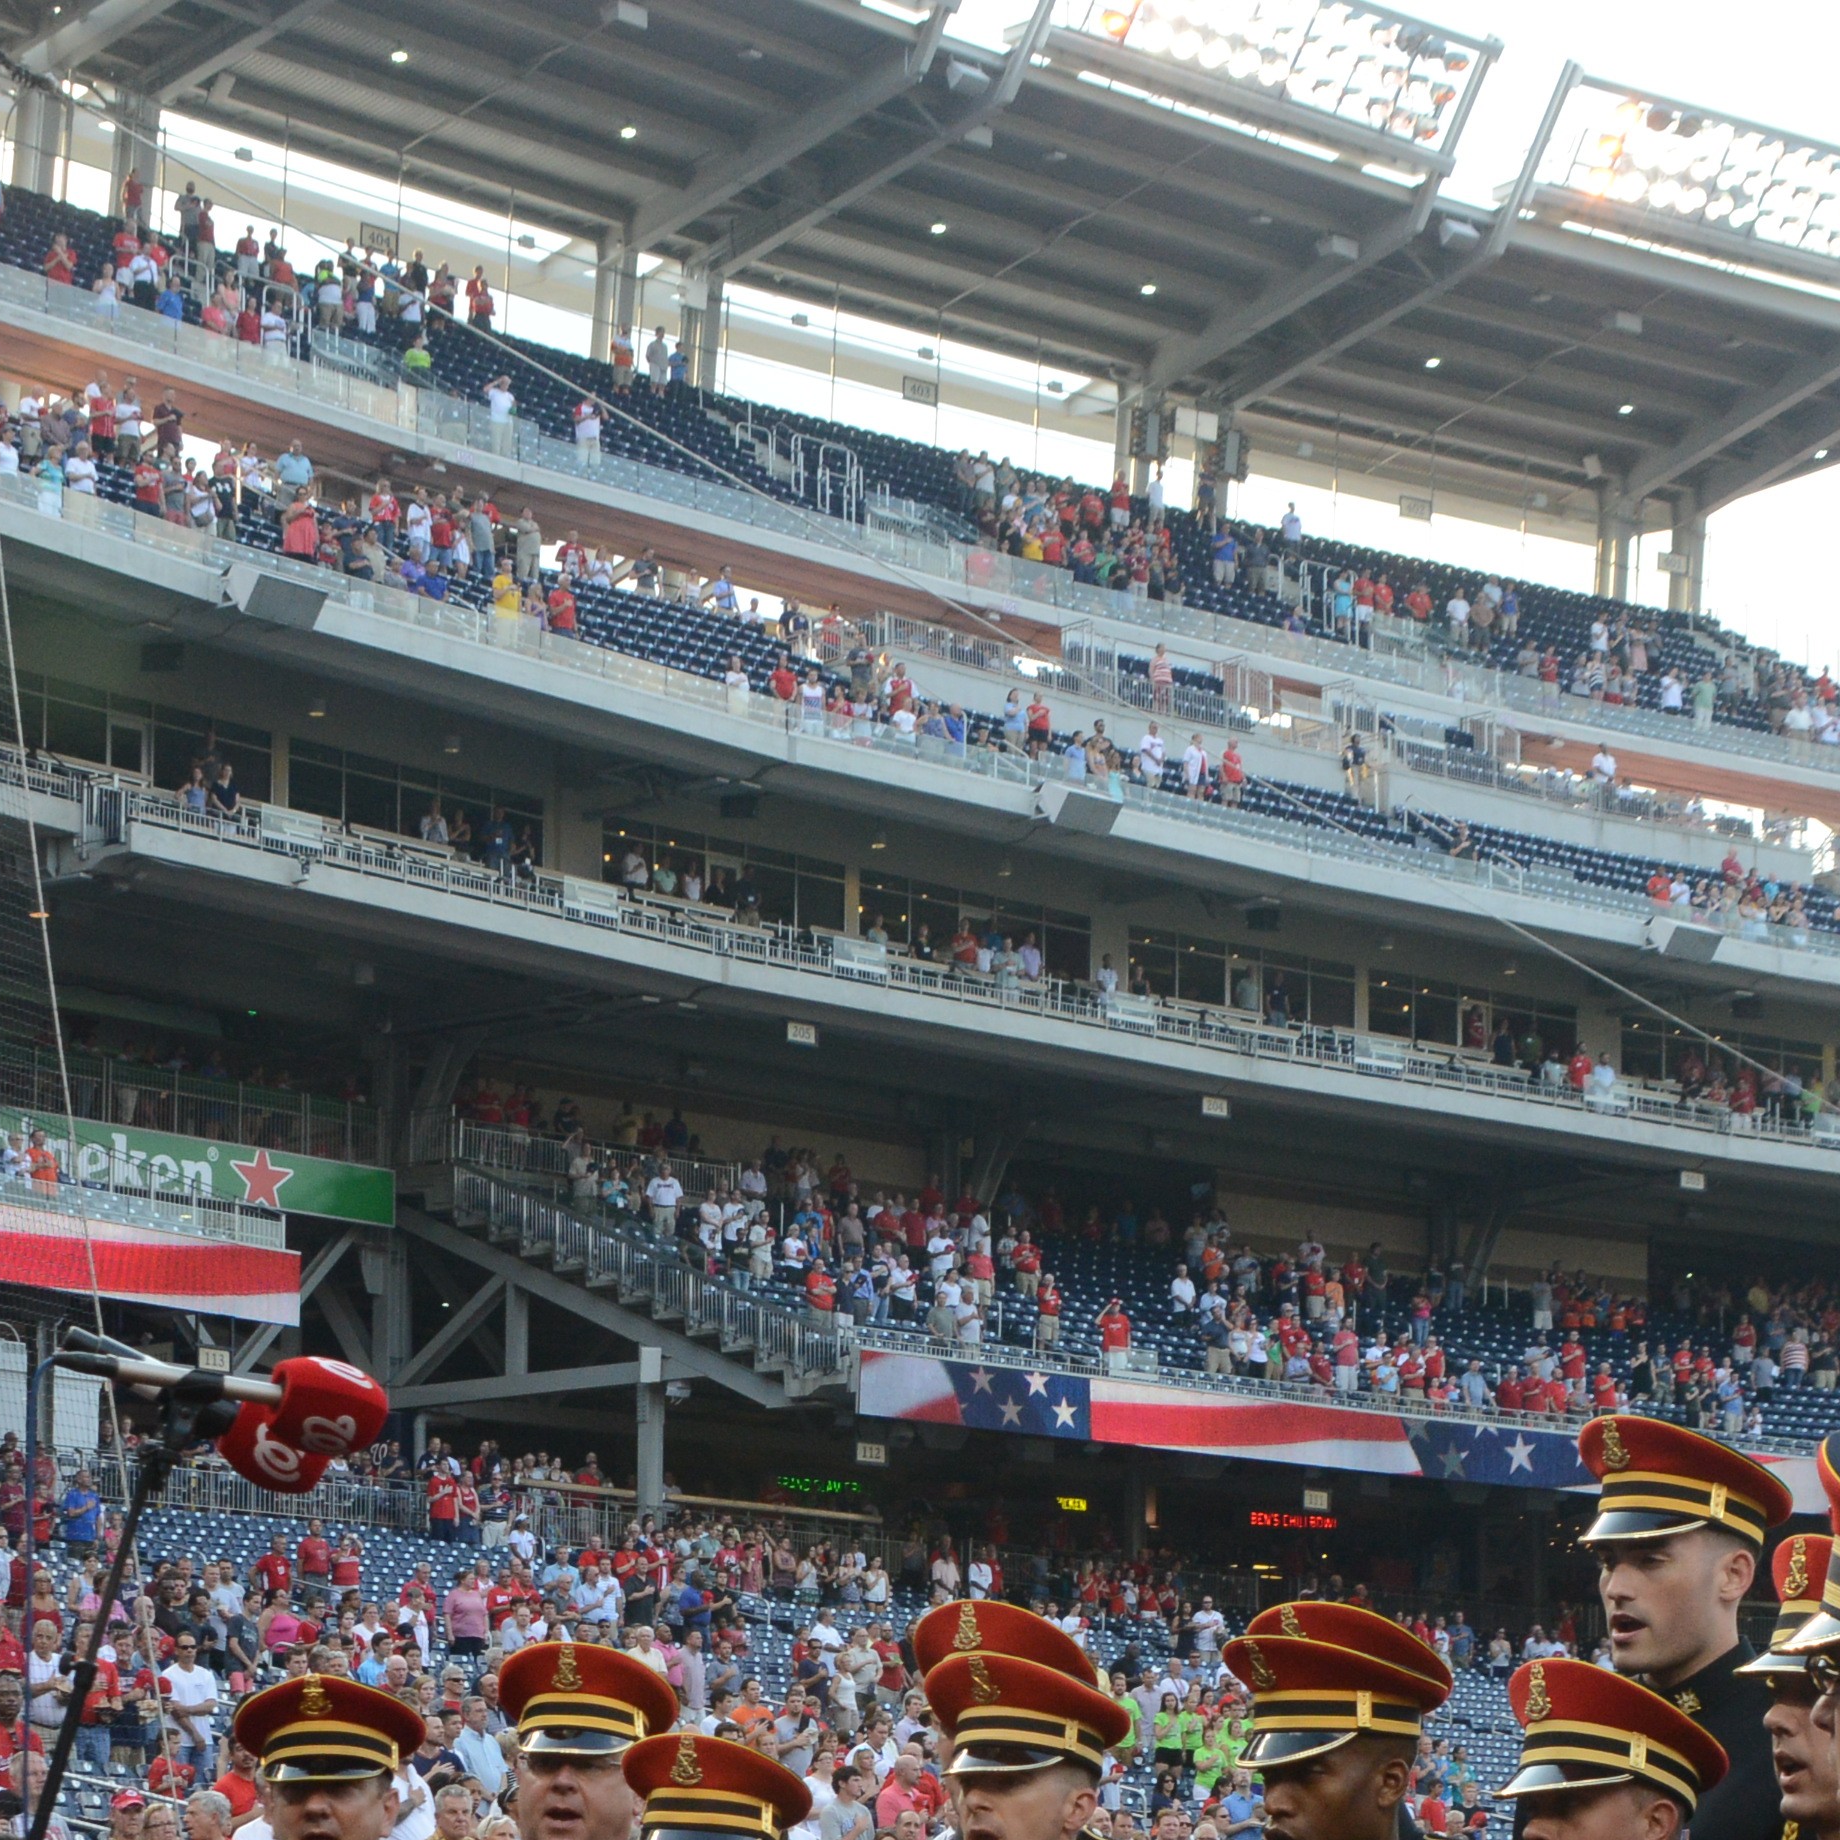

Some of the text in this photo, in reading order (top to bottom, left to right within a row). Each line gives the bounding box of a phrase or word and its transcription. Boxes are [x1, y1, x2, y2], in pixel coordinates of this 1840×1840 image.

[369, 231, 391, 246] 404
[792, 1025, 812, 1041] 205
[205, 1351, 225, 1368] 113
[862, 1445, 881, 1459] 112
[1250, 1511, 1280, 1526] BEN'S
